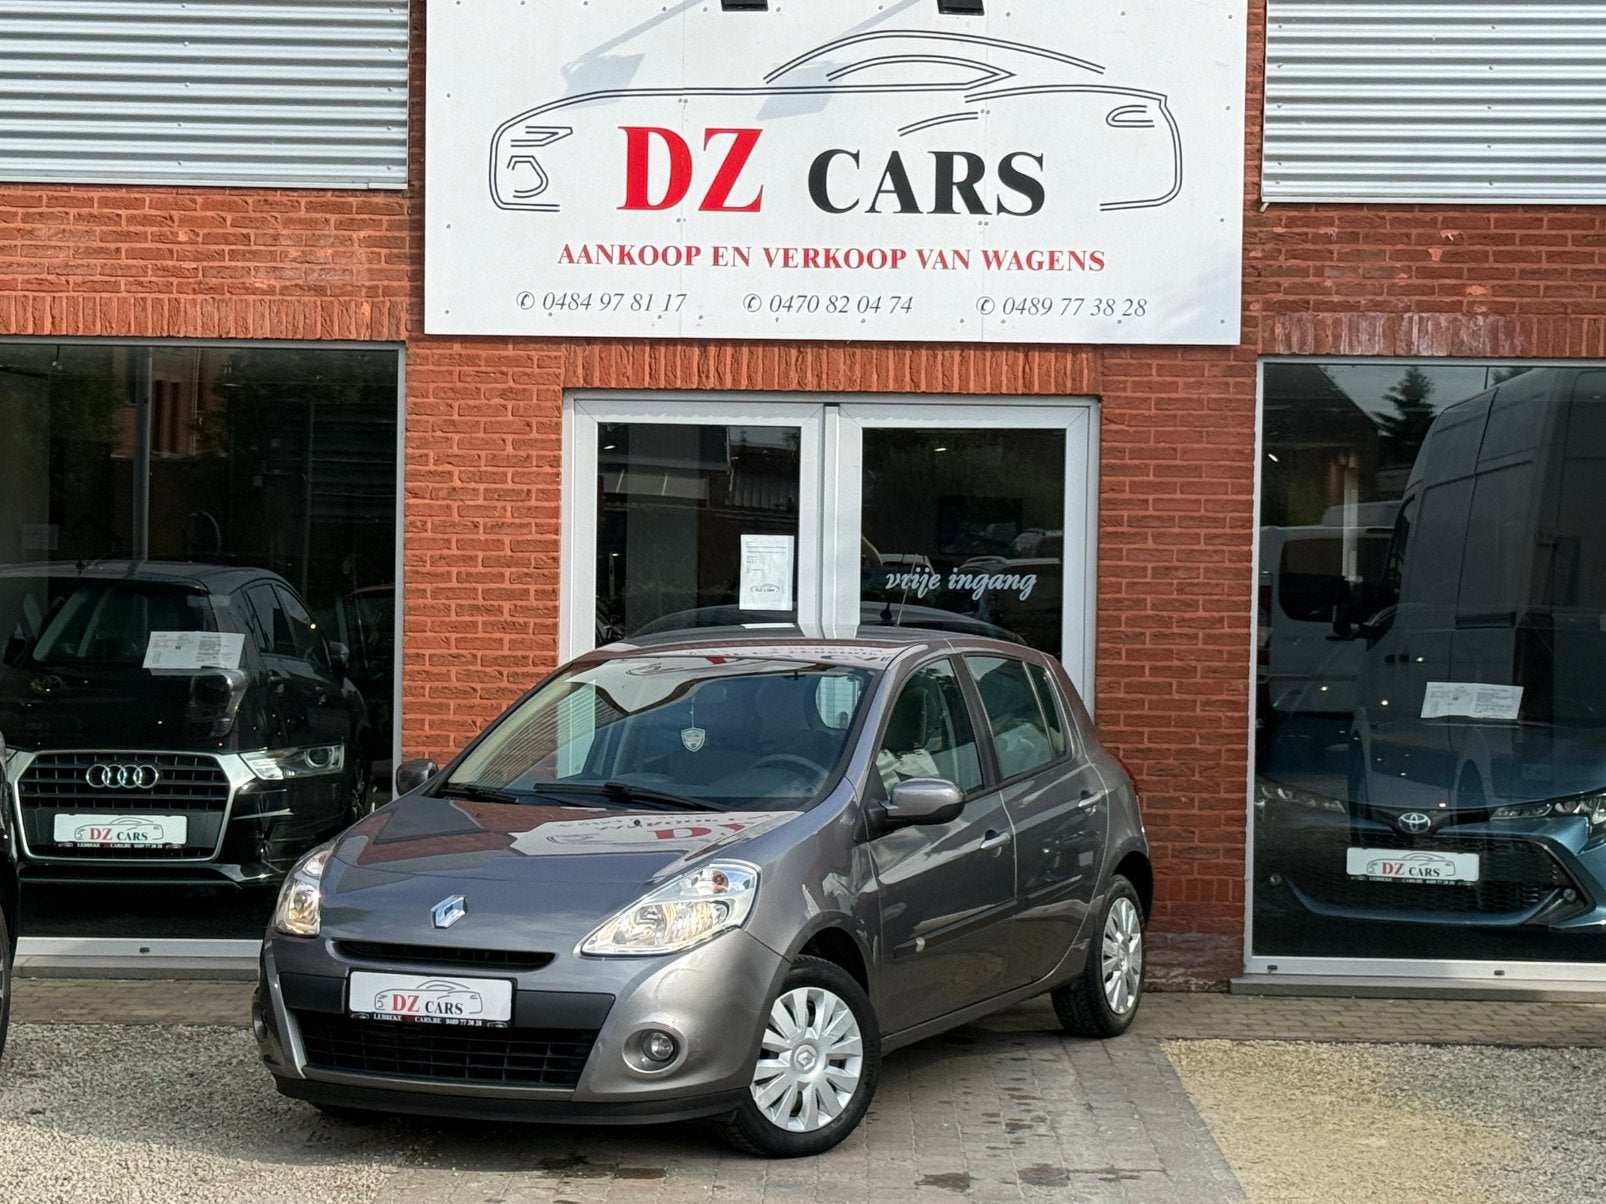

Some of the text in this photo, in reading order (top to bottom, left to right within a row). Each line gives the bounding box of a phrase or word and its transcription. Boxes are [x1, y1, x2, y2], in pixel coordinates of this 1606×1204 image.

[616, 126, 1045, 217] DZ CARS
[557, 243, 1105, 272] AANKOOP EN VERKOOP VAN WAGENS
[542, 292, 687, 312] 0484 97 81 17
[769, 294, 913, 314] 0470 82 04 74
[1002, 297, 1147, 317] 0489 77 38 28
[885, 567, 1037, 601] vrije ingang
[89, 827, 148, 841] DZ CARS
[1382, 862, 1440, 877] DZ CARS
[391, 993, 464, 1016] DZ CARS
